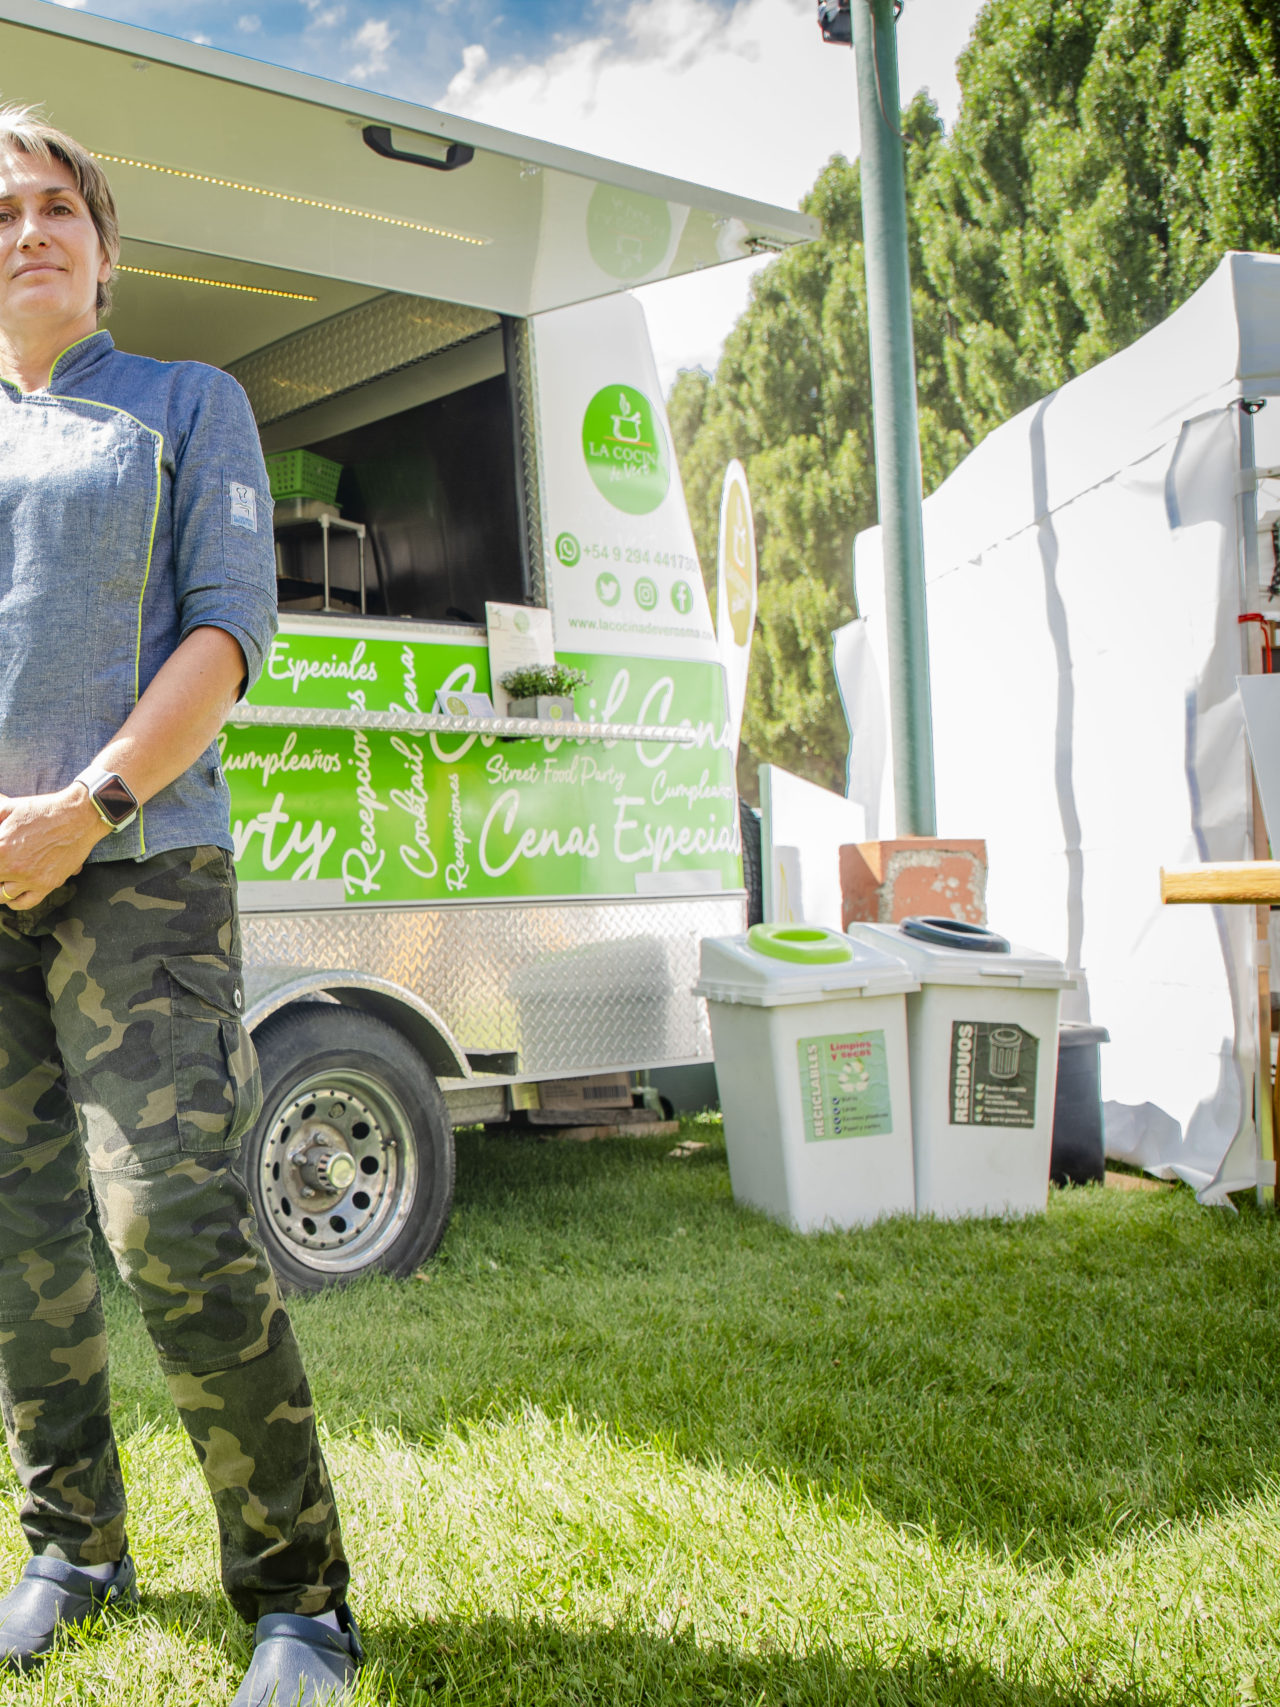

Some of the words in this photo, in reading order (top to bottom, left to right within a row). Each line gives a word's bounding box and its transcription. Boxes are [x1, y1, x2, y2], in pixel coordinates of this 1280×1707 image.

[589, 441, 610, 458] LA
[612, 446, 657, 465] COCIN
[583, 544, 609, 560] +54
[612, 546, 622, 561] 9
[624, 547, 650, 565] 294
[267, 640, 378, 694] Especiales
[390, 736, 438, 879] Cocktail
[486, 754, 541, 785] Street
[544, 755, 579, 785] Food
[580, 757, 627, 792] Party
[445, 773, 472, 892] Recepciones
[479, 789, 601, 878] Cenas
[830, 1041, 871, 1052] Limpios
[954, 1024, 974, 1123] RESIDUOS
[807, 1043, 825, 1137] RECICLABLES
